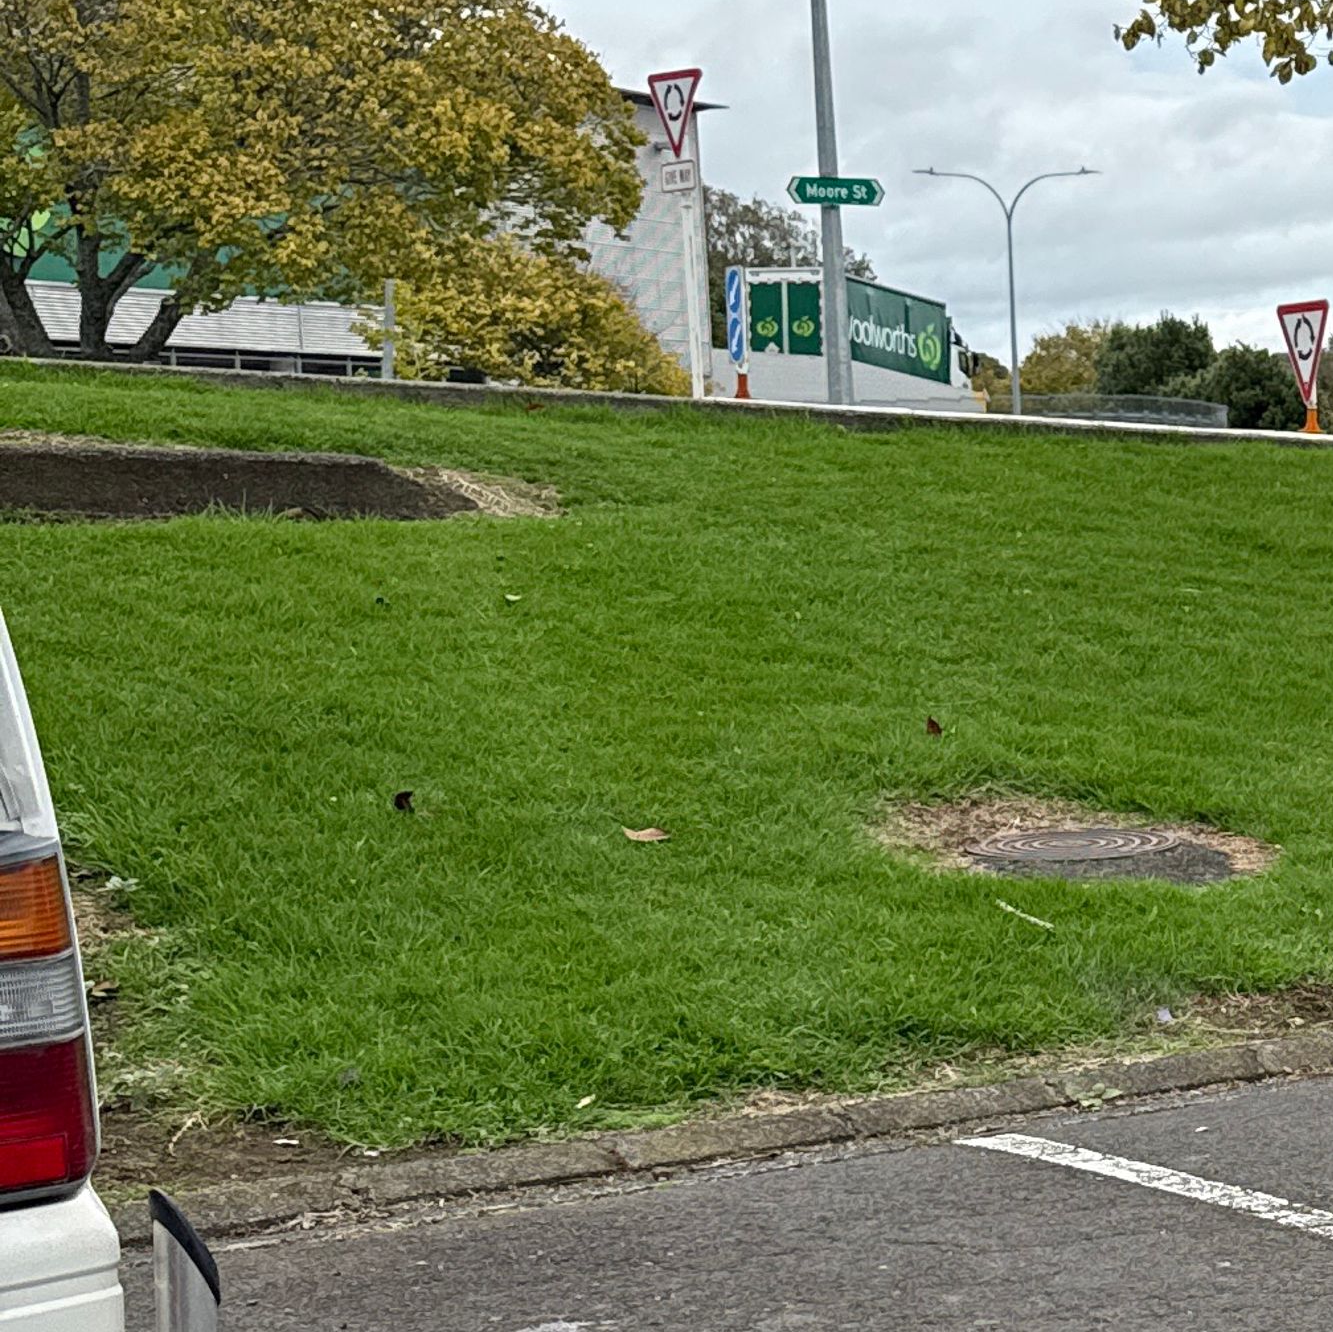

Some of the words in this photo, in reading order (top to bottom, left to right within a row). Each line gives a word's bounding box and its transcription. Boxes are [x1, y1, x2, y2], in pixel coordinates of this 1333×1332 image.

[805, 182, 849, 200] Moore
[851, 184, 869, 200] St
[848, 314, 918, 359] oolworths
